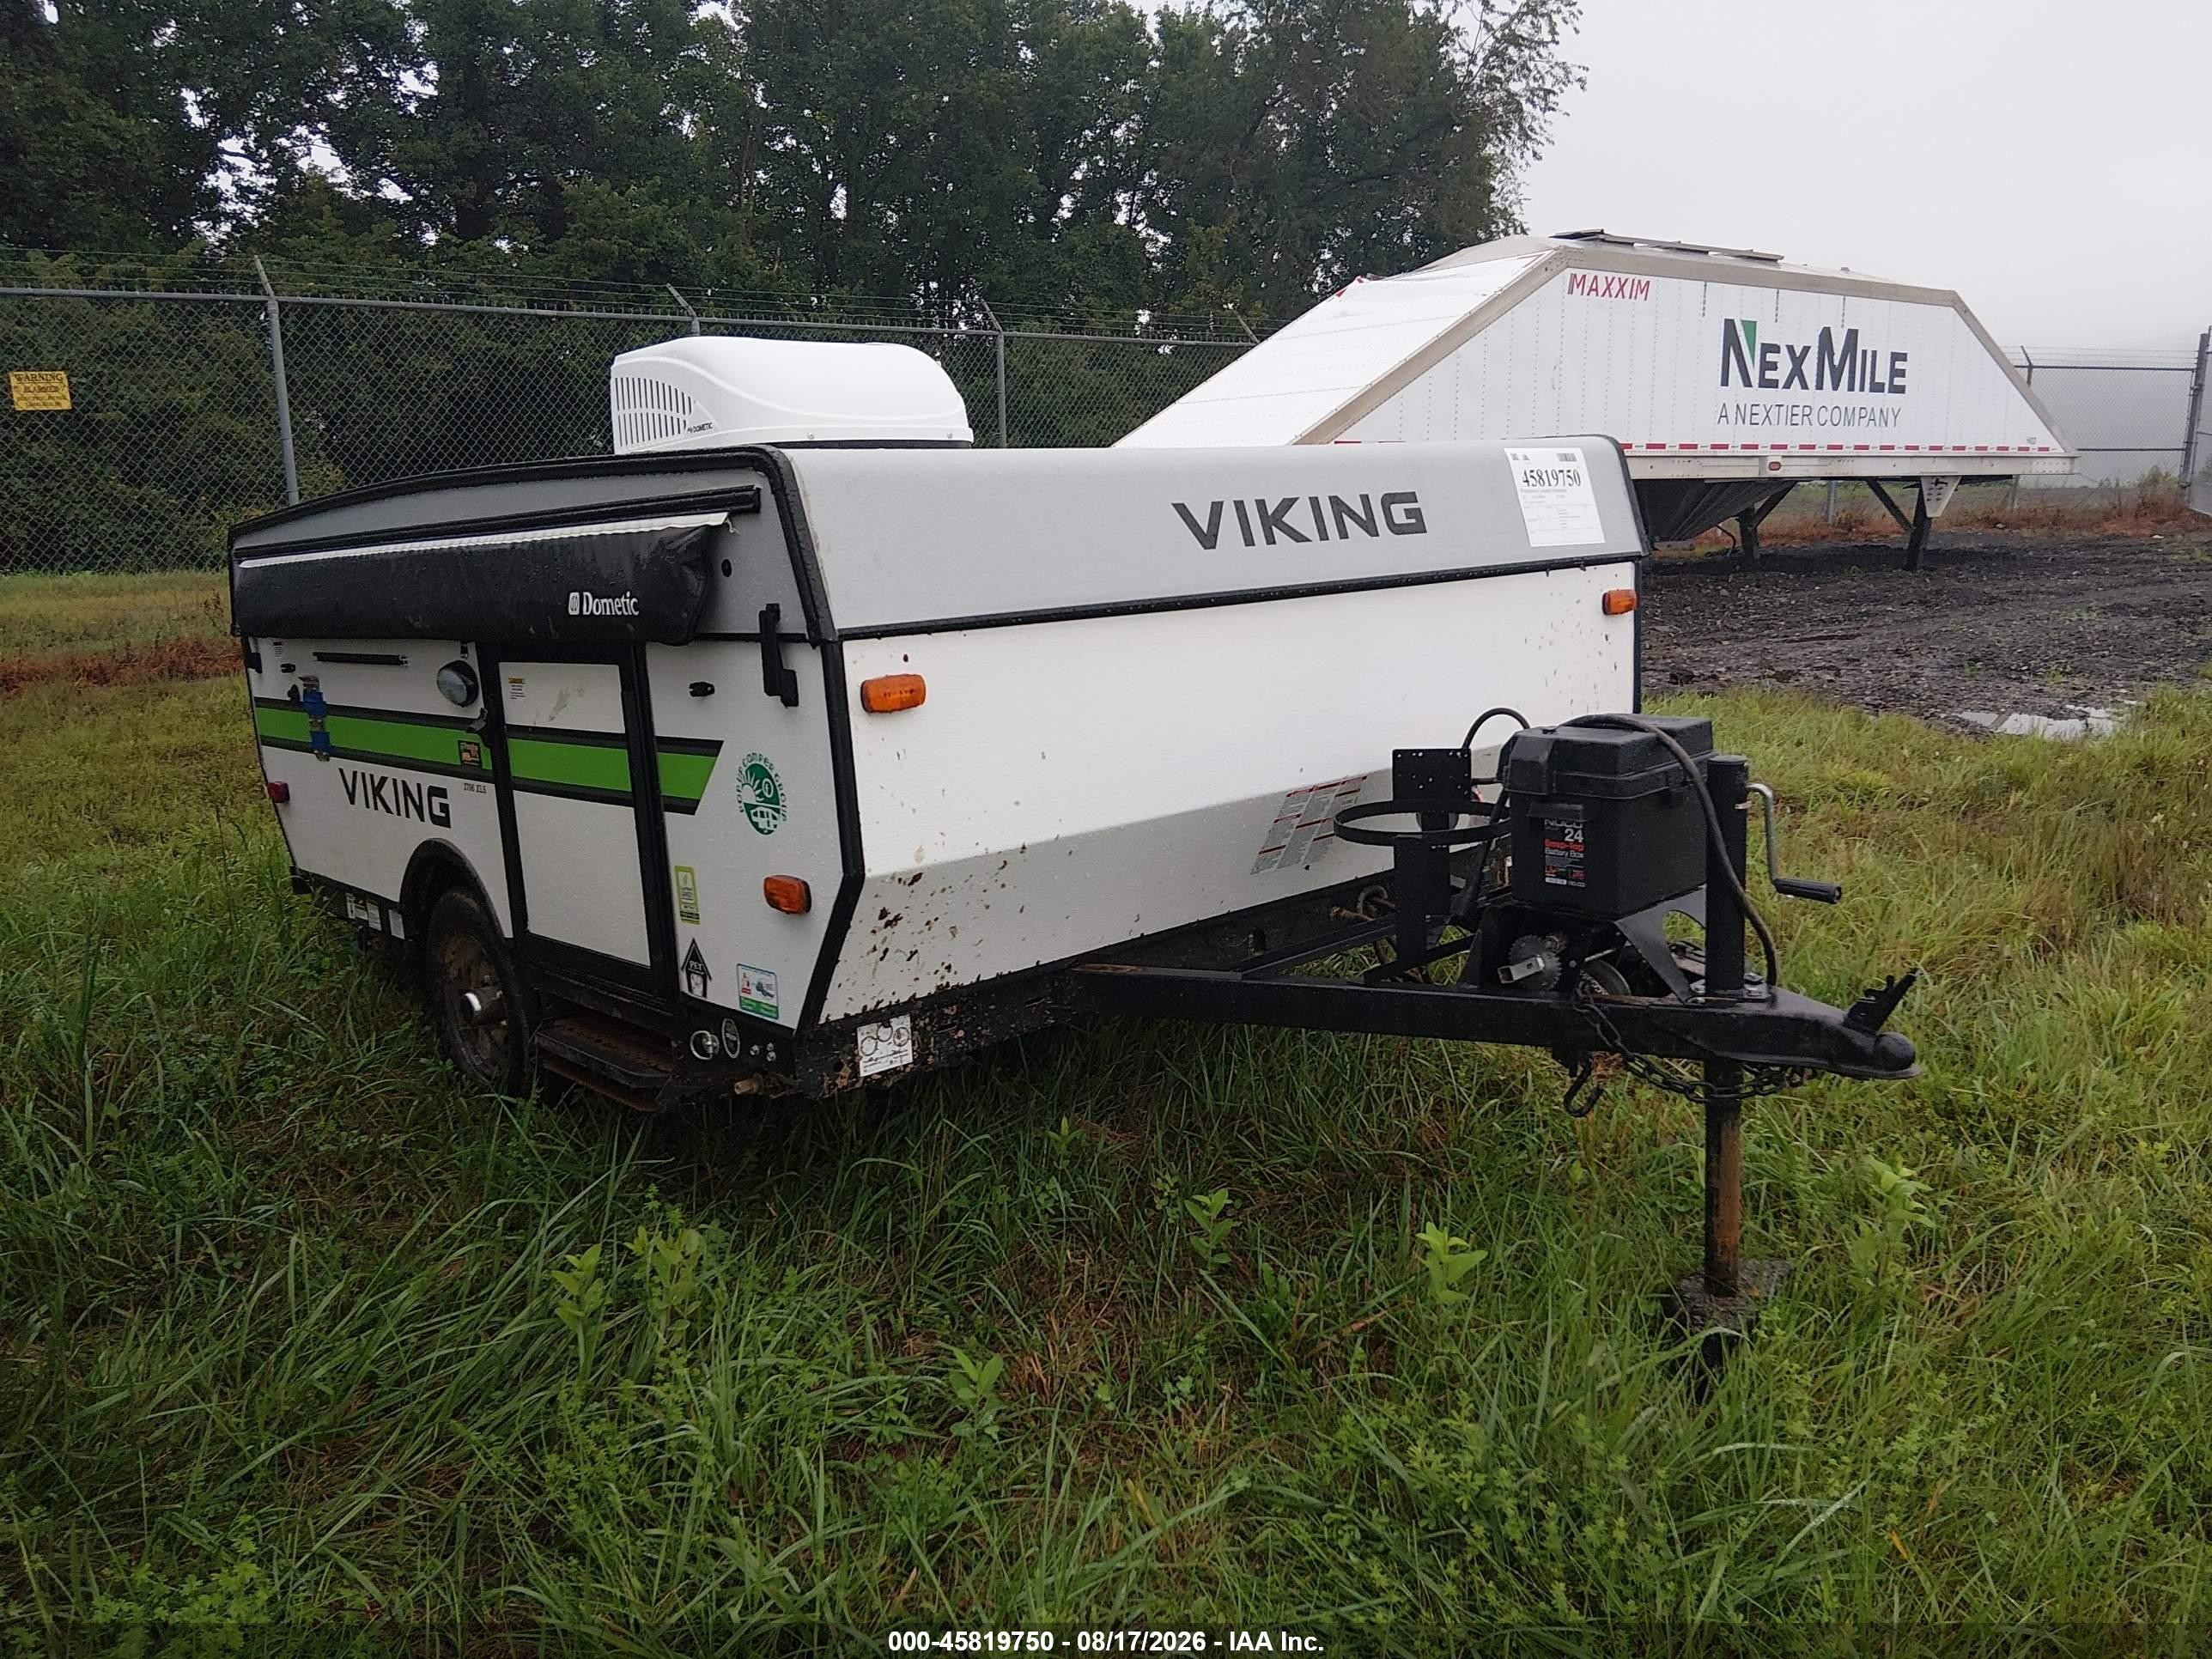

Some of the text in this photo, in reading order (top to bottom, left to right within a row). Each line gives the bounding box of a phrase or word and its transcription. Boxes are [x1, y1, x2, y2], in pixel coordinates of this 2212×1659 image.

[1568, 273, 1650, 301] MAXXIM
[15, 373, 63, 382] WARNING
[1717, 403, 1901, 428] A NEXTIER COMPANY
[1522, 469, 1581, 487] 45819750
[1171, 491, 1427, 550] VIKING
[582, 591, 639, 616] Dometic
[338, 768, 452, 829] VIKING
[1565, 828, 1583, 842] 24
[690, 960, 704, 971] PET
